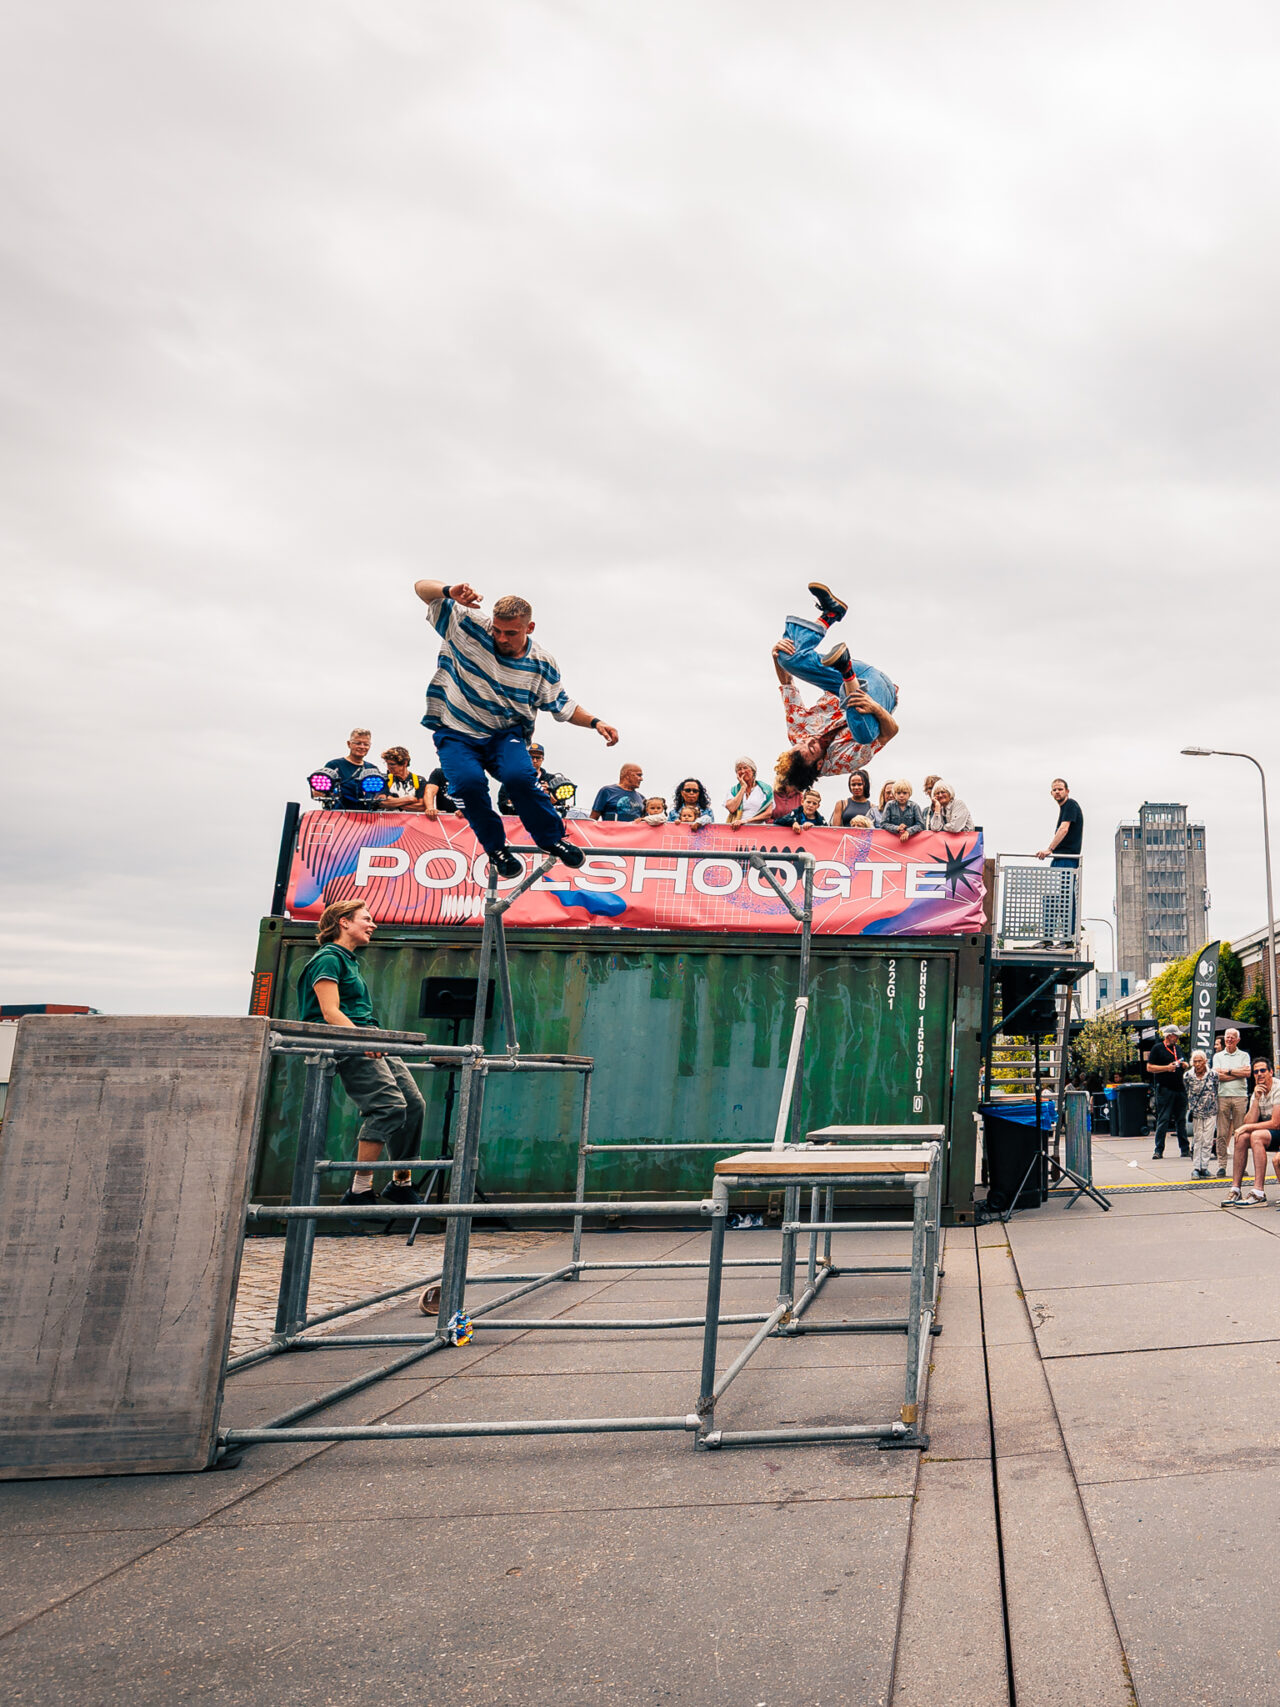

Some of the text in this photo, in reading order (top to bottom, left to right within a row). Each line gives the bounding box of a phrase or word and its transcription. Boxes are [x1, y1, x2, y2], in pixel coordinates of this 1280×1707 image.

[354, 846, 948, 900] POOLSHOOGTE
[886, 960, 896, 1010] 22G1
[914, 960, 927, 1111] CHSU 156301 0
